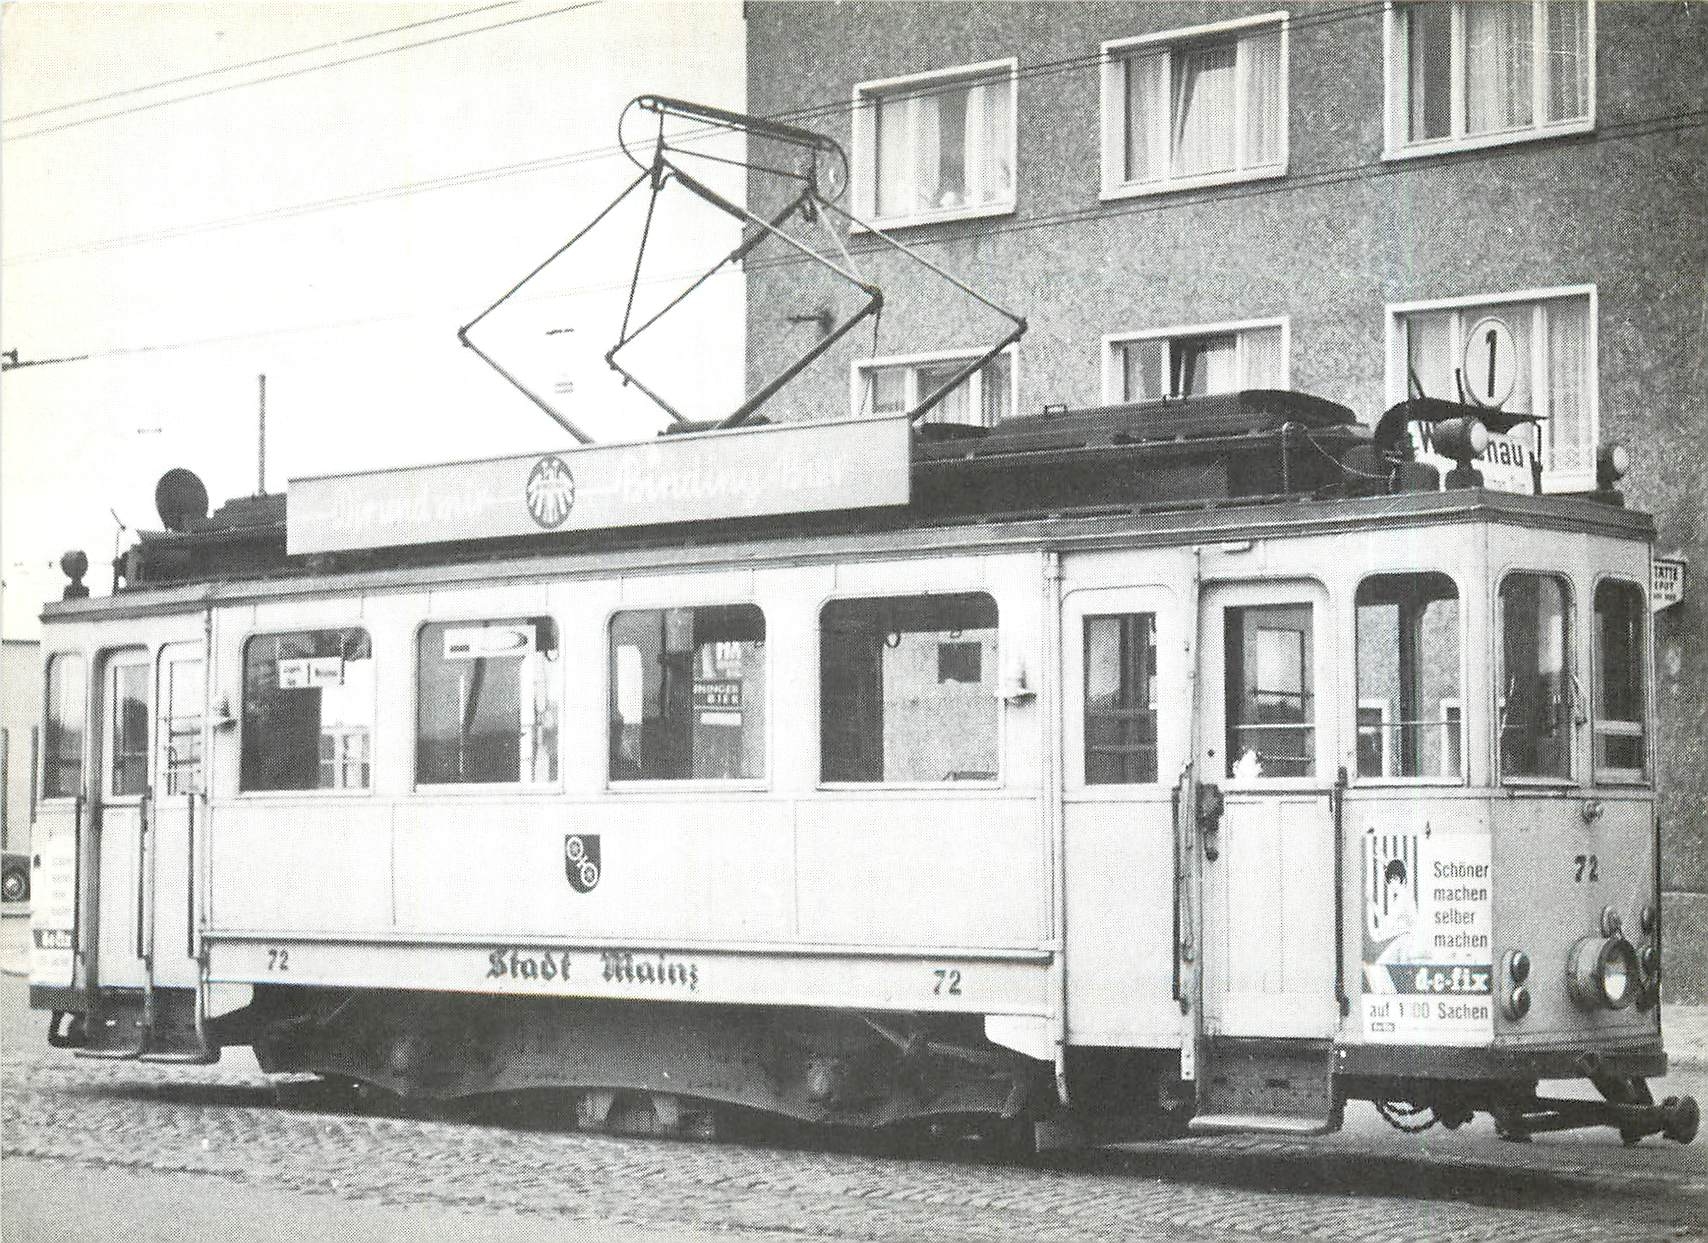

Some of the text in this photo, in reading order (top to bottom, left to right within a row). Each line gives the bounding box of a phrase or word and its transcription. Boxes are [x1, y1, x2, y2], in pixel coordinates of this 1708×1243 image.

[1485, 329, 1498, 398] 1
[1432, 860, 1489, 879] Schöner
[1574, 854, 1599, 883] 72
[1433, 886, 1488, 902] machen
[1433, 909, 1476, 925] selber
[1433, 932, 1488, 948] machen
[267, 949, 290, 971] 72
[485, 947, 700, 992] Stadt Mainz
[932, 969, 963, 996] 72
[1369, 1001, 1390, 1018] auf
[1437, 1001, 1489, 1020] Sachen
